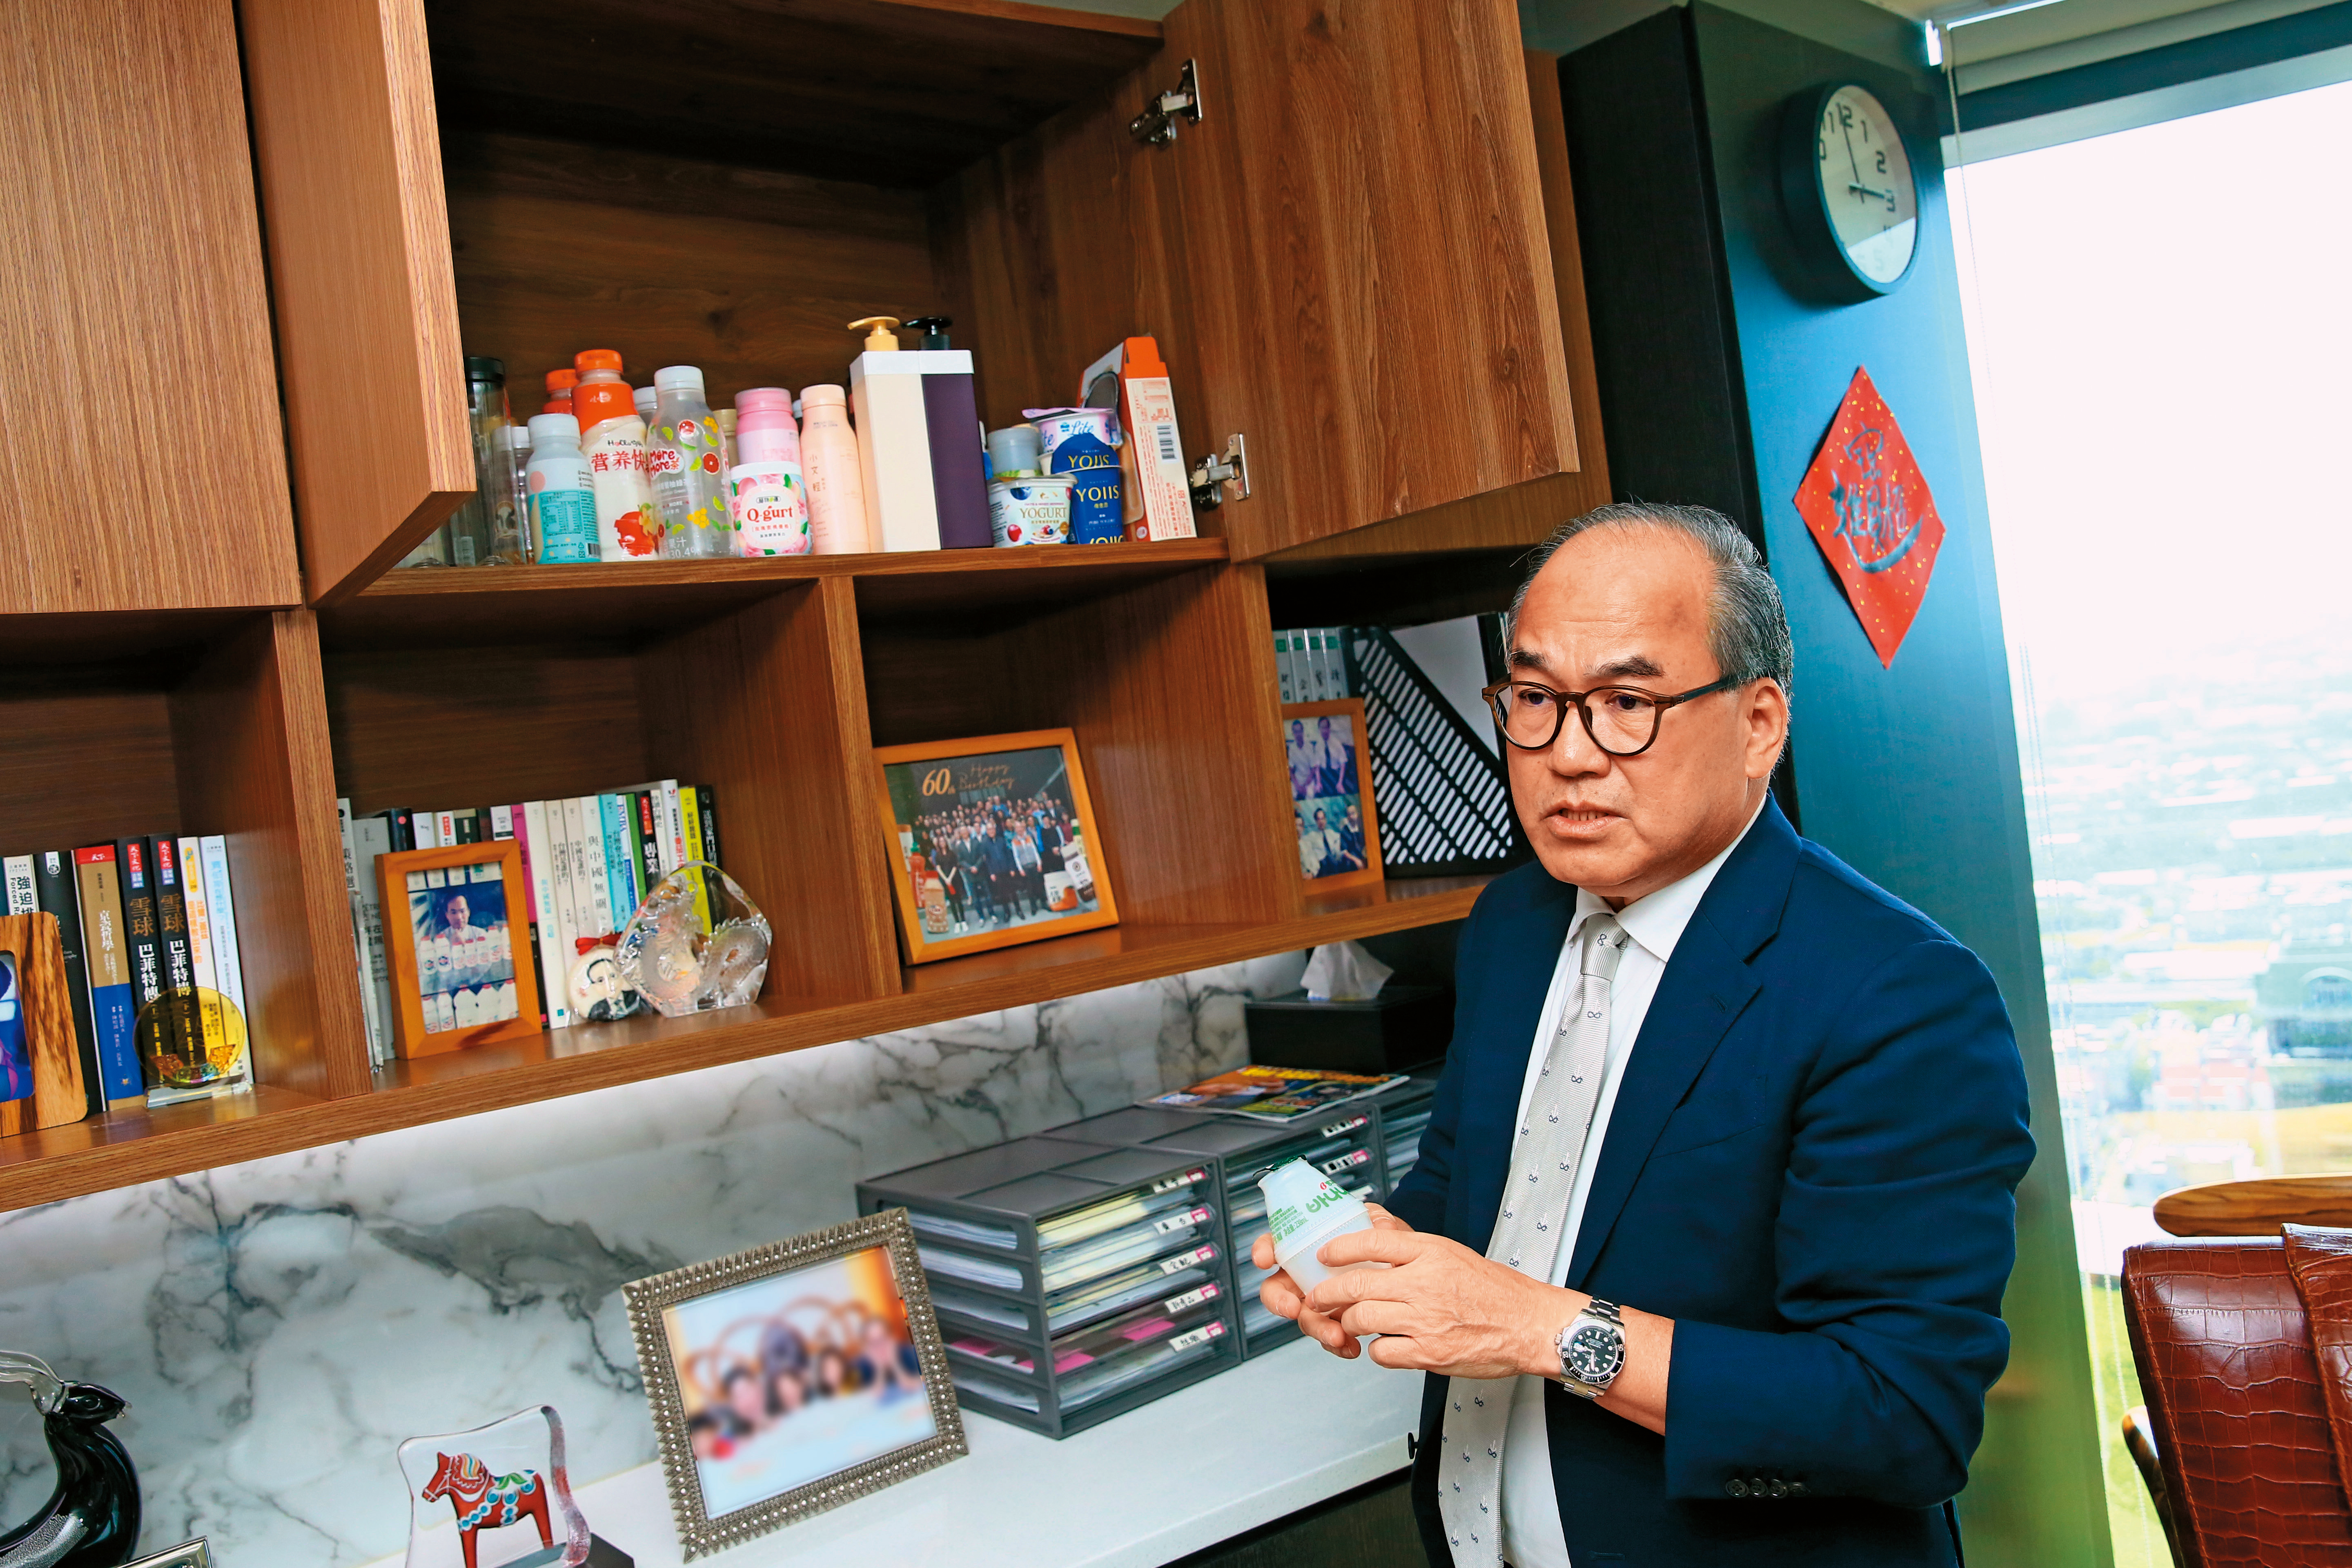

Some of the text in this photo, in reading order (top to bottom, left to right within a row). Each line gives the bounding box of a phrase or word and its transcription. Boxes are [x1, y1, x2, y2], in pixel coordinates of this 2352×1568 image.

[1861, 120, 1868, 144] 1
[1876, 150, 1886, 174] 2
[1885, 189, 1896, 212] 3
[591, 449, 650, 473] 营养快
[747, 506, 793, 523] Q-gurt
[1019, 507, 1066, 519] YOGURT
[644, 842, 660, 875] 專業
[588, 835, 607, 909] 與中國無關
[11, 878, 19, 904] Forced
[129, 896, 154, 937] 雪球
[161, 893, 185, 933] 雪球
[138, 943, 162, 1002] 巴菲特傳
[169, 939, 192, 998] 巴菲特傳
[1562, 1351, 1568, 1359] 20
